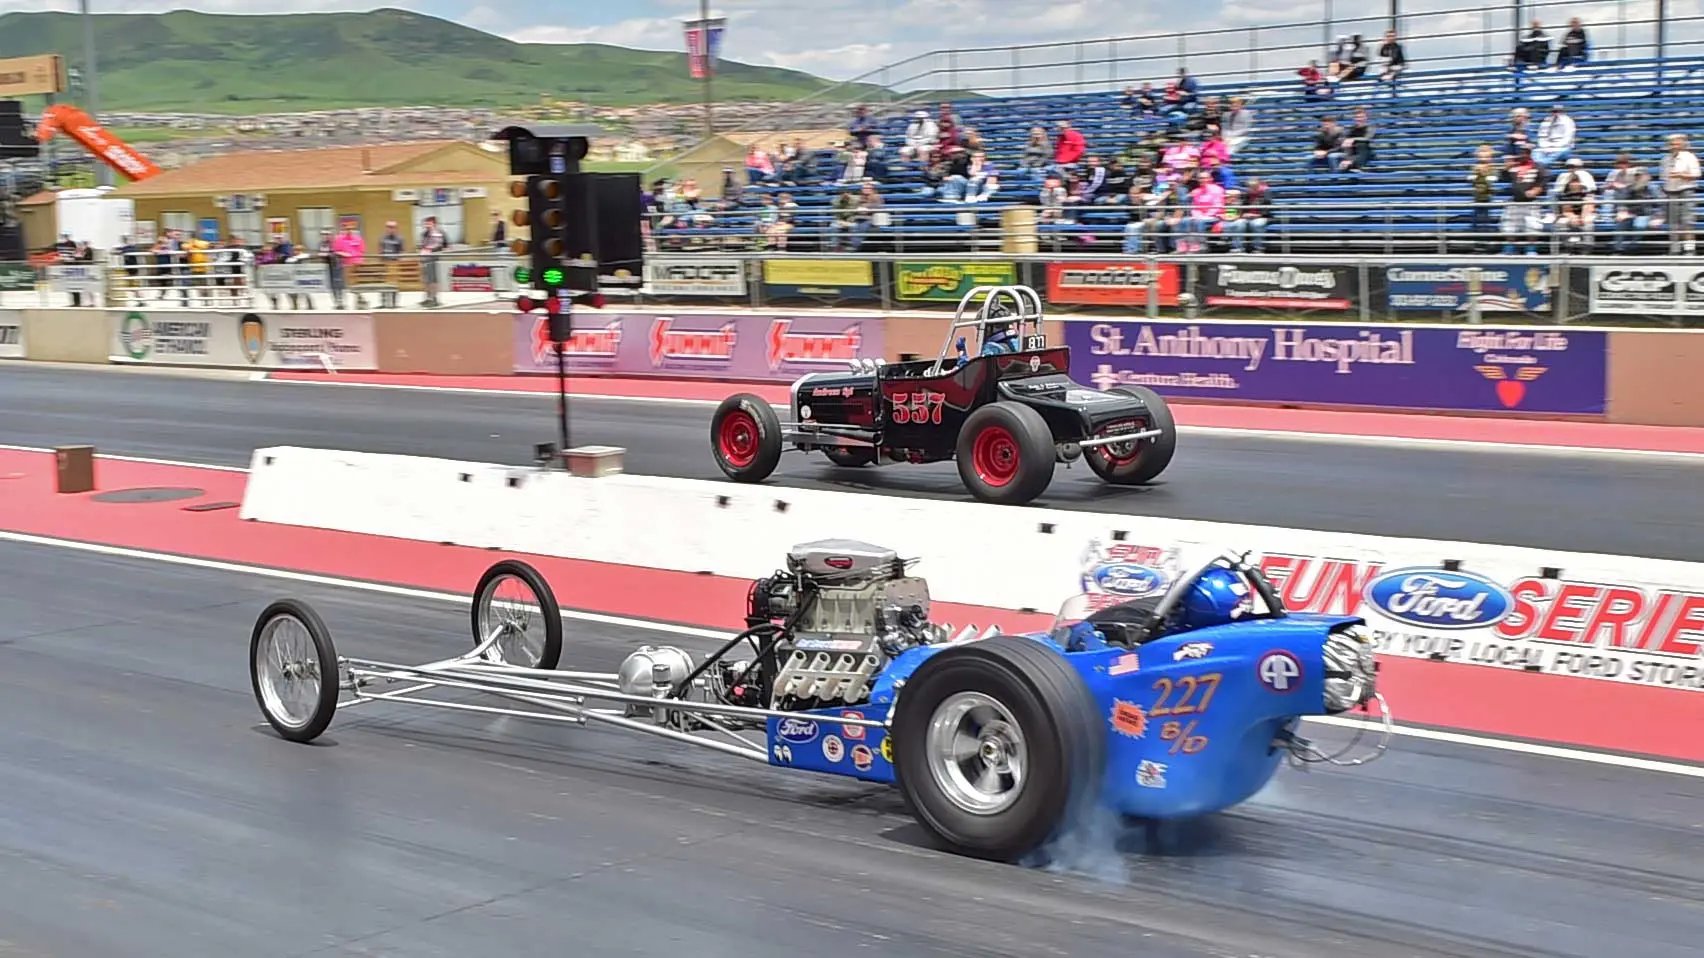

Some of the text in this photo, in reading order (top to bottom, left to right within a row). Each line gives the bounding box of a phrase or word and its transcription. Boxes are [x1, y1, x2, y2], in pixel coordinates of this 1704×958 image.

[1090, 324, 1416, 373] St. Anthony Hospital
[892, 392, 946, 424] 557
[1099, 566, 1155, 592] Ford
[1250, 556, 1386, 615] FUN
[1387, 575, 1489, 621] Ford
[1401, 632, 1465, 659] YOUR
[1470, 642, 1545, 666] LOCAL
[1551, 650, 1621, 680] FORD
[1148, 672, 1224, 717] 227
[780, 718, 814, 736] Ford
